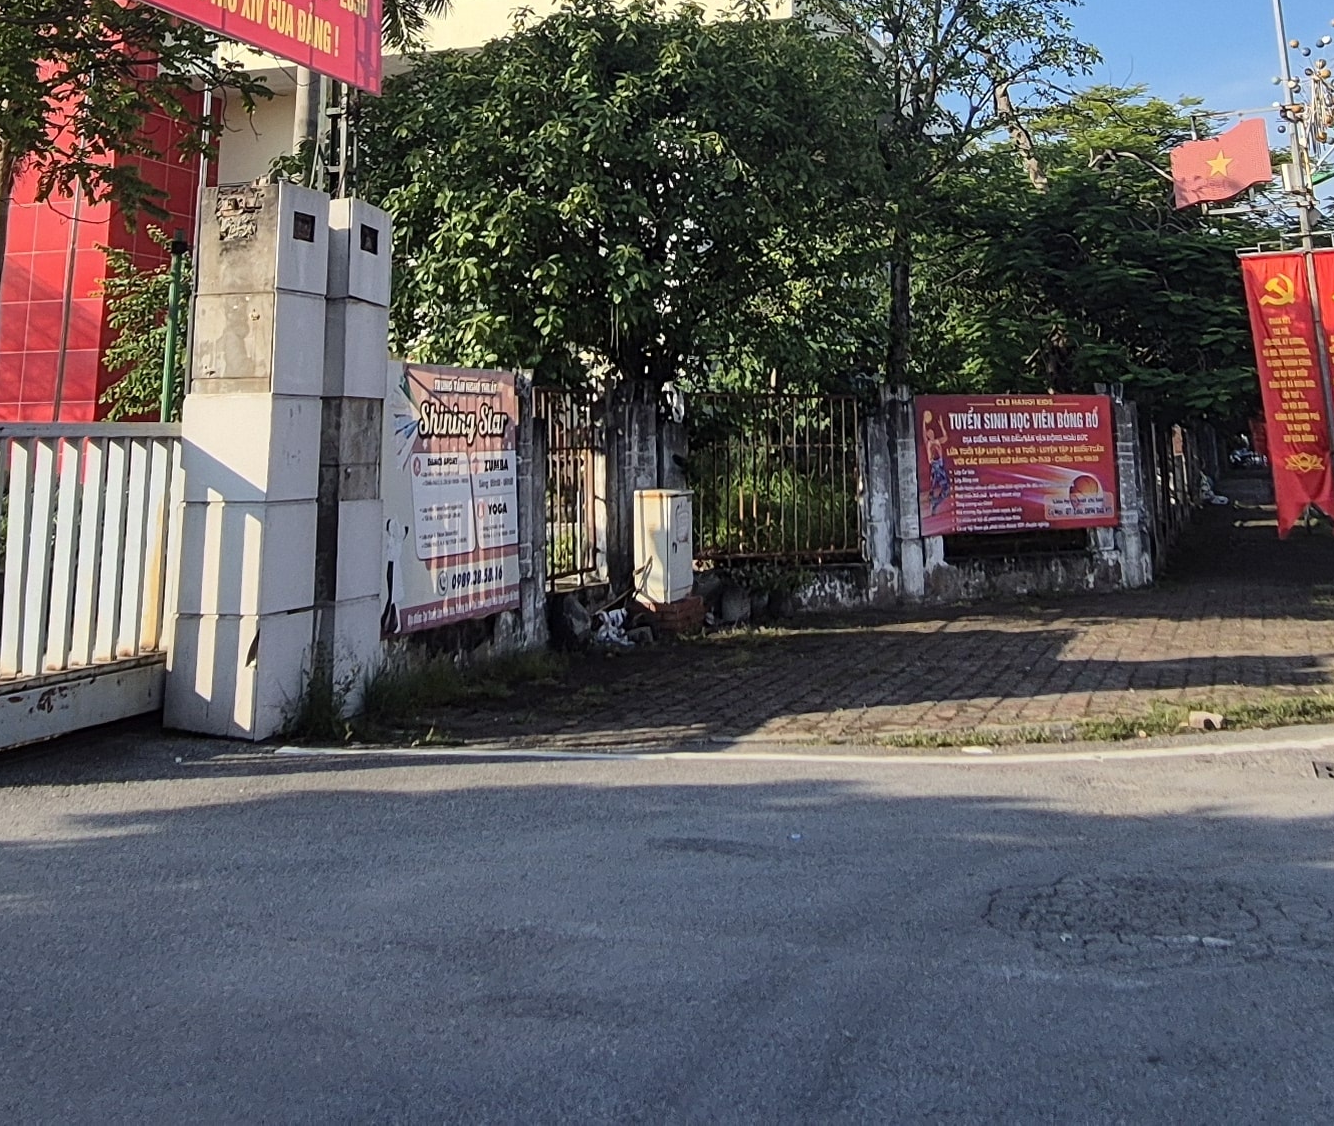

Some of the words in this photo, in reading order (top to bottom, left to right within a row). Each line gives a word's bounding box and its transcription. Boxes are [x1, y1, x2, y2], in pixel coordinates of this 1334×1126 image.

[297, 1, 332, 57] ĐẢNG
[418, 400, 477, 447] Shining
[478, 402, 509, 439] Star
[948, 407, 982, 430] TUYỂN
[983, 412, 1009, 429] SINH
[1010, 412, 1030, 434] HỌC
[1031, 409, 1055, 429] VIÊN
[1057, 409, 1084, 428] BÓNG
[483, 458, 509, 472] ZUMBA
[487, 502, 508, 515] YOGA
